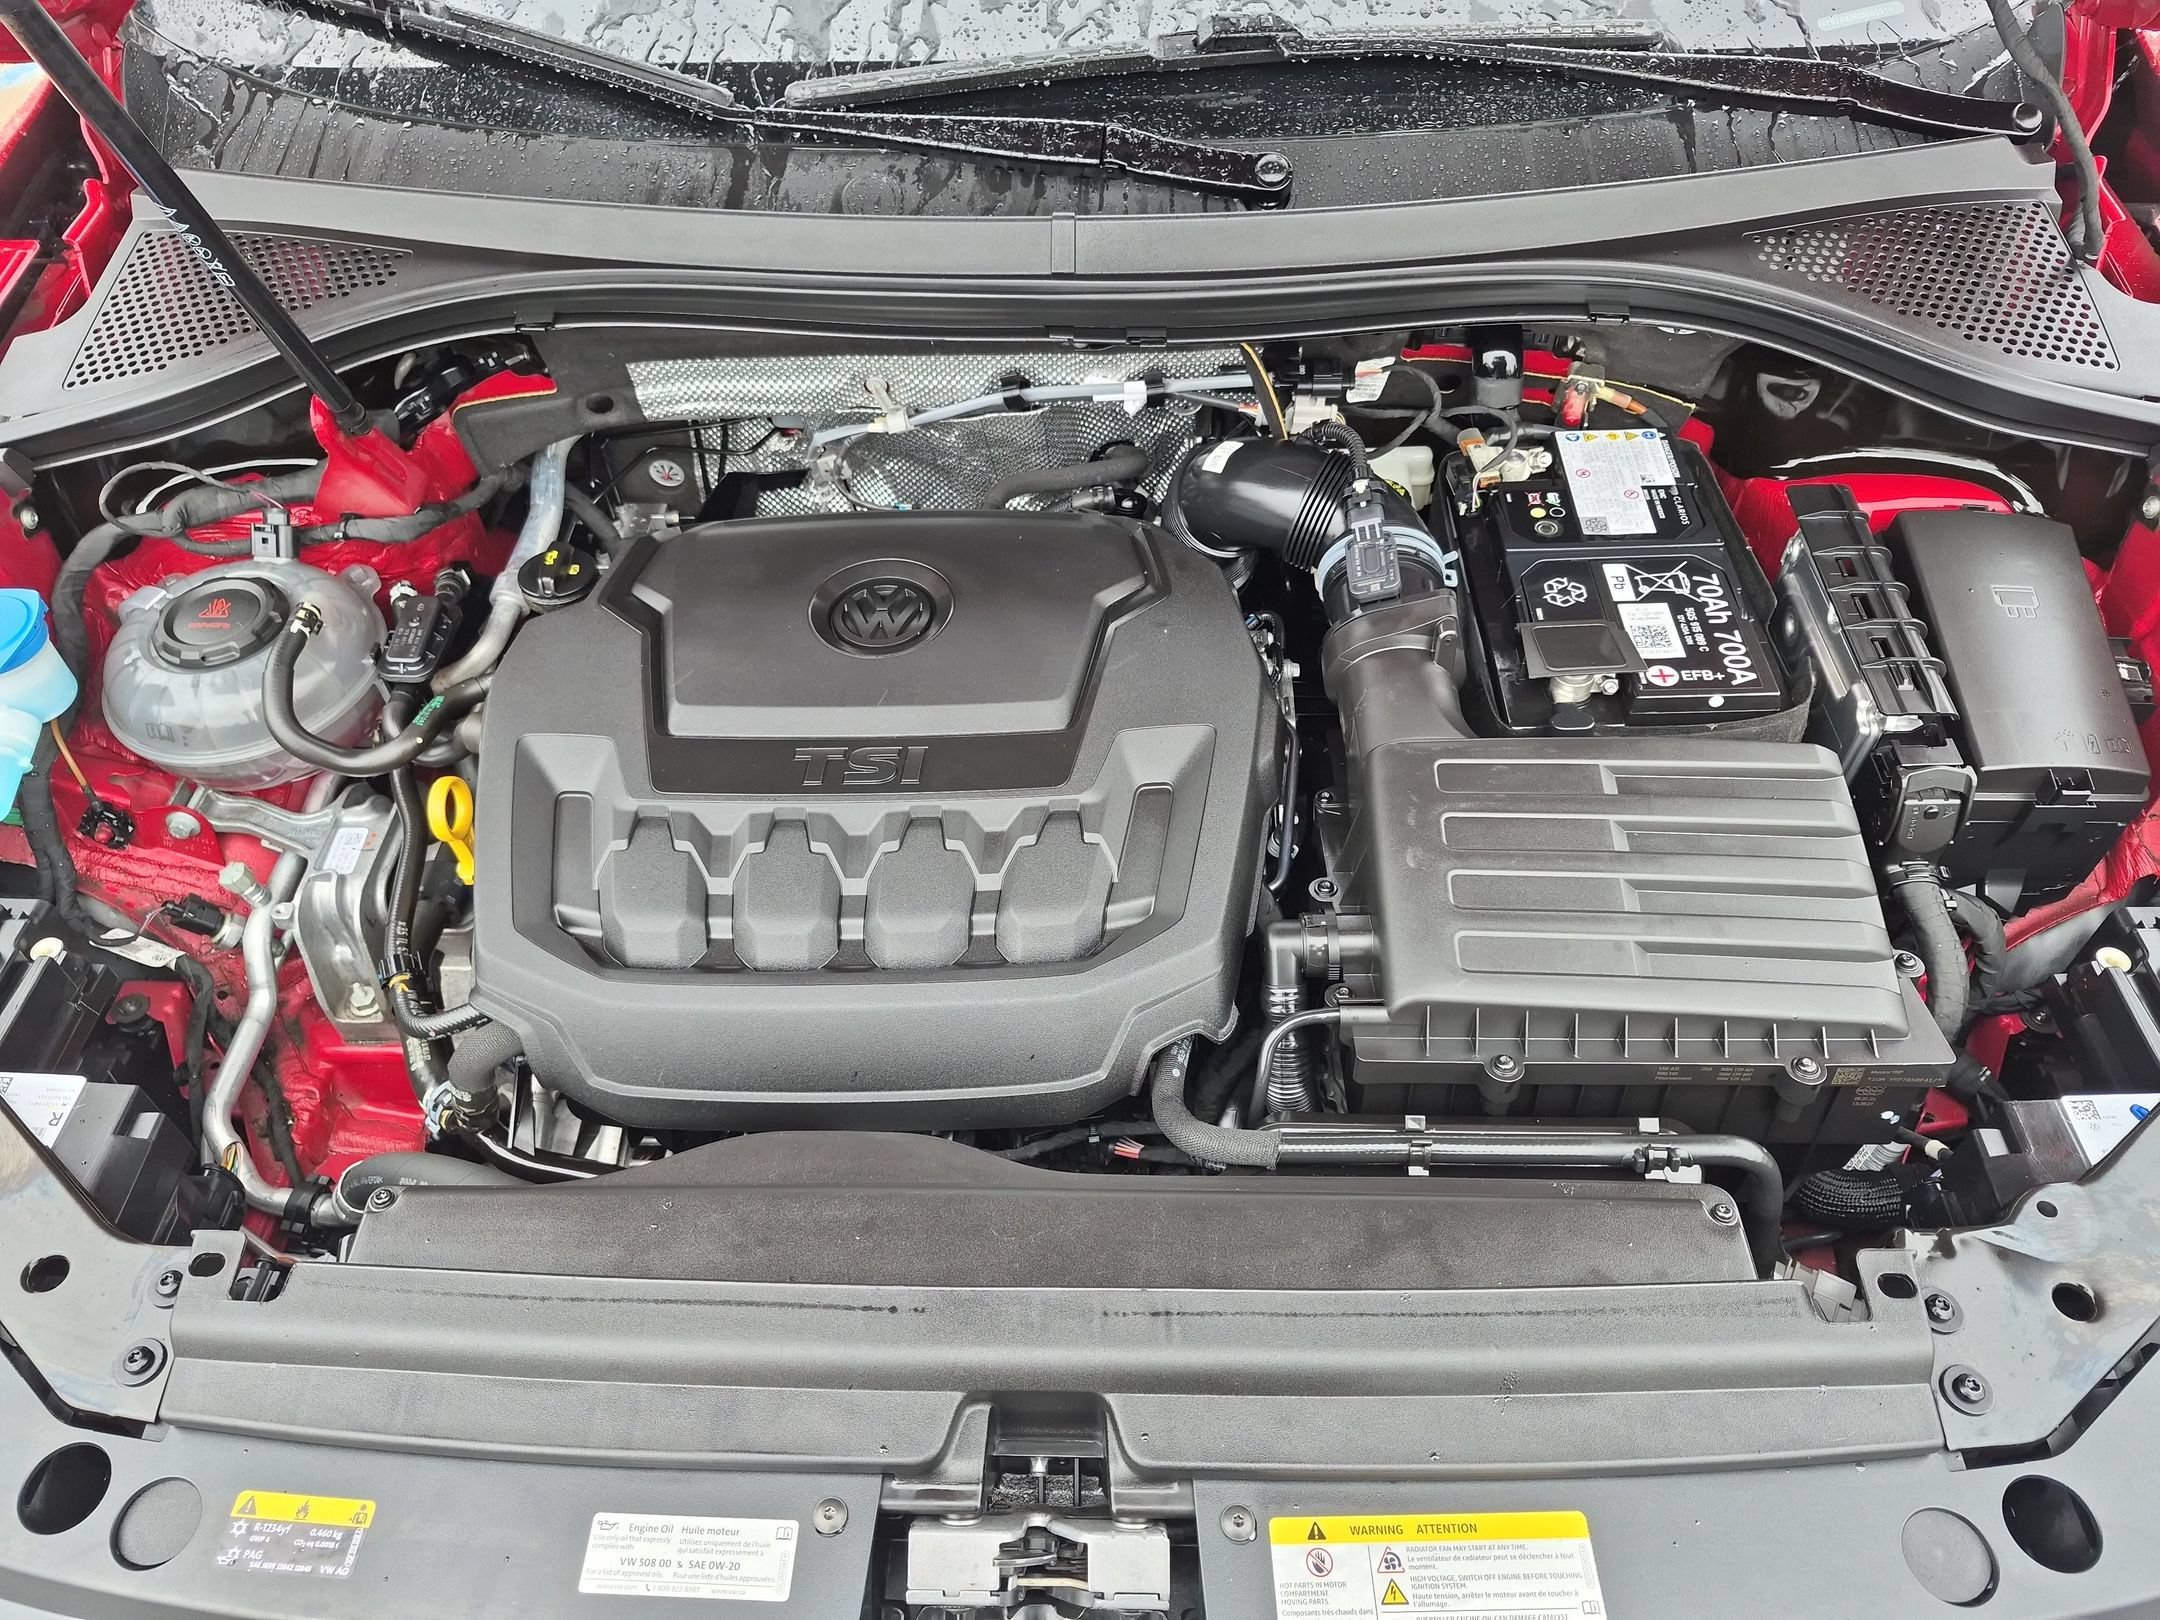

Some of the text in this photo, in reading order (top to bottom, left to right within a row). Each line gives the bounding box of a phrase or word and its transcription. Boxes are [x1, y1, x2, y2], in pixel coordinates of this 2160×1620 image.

[1673, 496, 1690, 525] CLARIOS
[1610, 575, 1625, 590] Pb
[1692, 573, 1757, 685] 70Ah 700A
[1680, 670, 1725, 681] EFB+
[794, 746, 928, 786] TSI
[48, 1112, 64, 1126] R
[254, 1523, 343, 1540] R-1234yf 0.460 kg
[629, 1523, 739, 1536] Engine Oil Huile moteur
[1350, 1523, 1478, 1535] WARNING ATTENTION
[703, 1539, 741, 1547] uniquement
[243, 1550, 264, 1559] PAG
[1493, 1554, 1509, 1562] peut
[1519, 1552, 1553, 1560] déclencher
[620, 1557, 637, 1566] VW
[639, 1558, 656, 1567] 508
[659, 1559, 672, 1568] 00
[689, 1560, 706, 1569] SAE
[709, 1561, 740, 1571] 0W-20
[320, 1566, 335, 1574] VW
[335, 1566, 350, 1575] AG
[620, 1570, 650, 1578] approved
[715, 1573, 738, 1581] d'huiles
[1413, 1592, 1435, 1600] Haute
[1436, 1592, 1460, 1600] tension,
[1462, 1591, 1484, 1599] arrêter
[1413, 1600, 1450, 1608] l'allumage.
[1282, 1609, 1321, 1617] Composants
